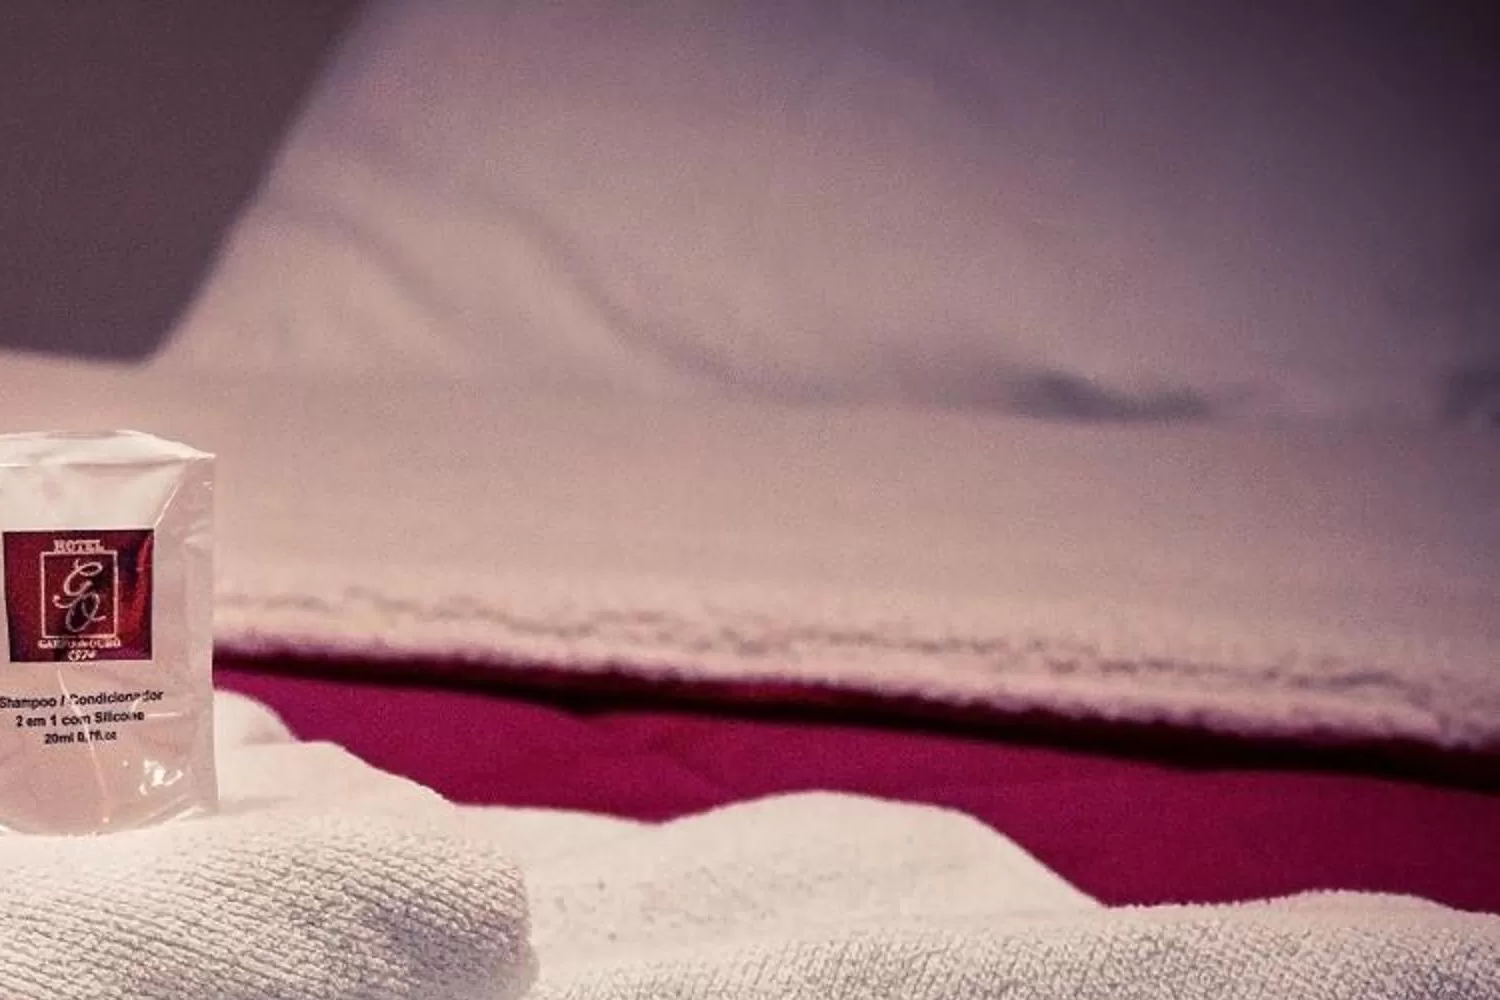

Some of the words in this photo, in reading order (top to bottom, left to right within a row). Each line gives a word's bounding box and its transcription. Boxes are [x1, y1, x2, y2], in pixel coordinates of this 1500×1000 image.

[53, 539, 104, 551] HOTEL
[16, 715, 23, 727] 2
[26, 717, 47, 726] em
[50, 715, 57, 726] 1
[44, 731, 74, 744] 20ml
